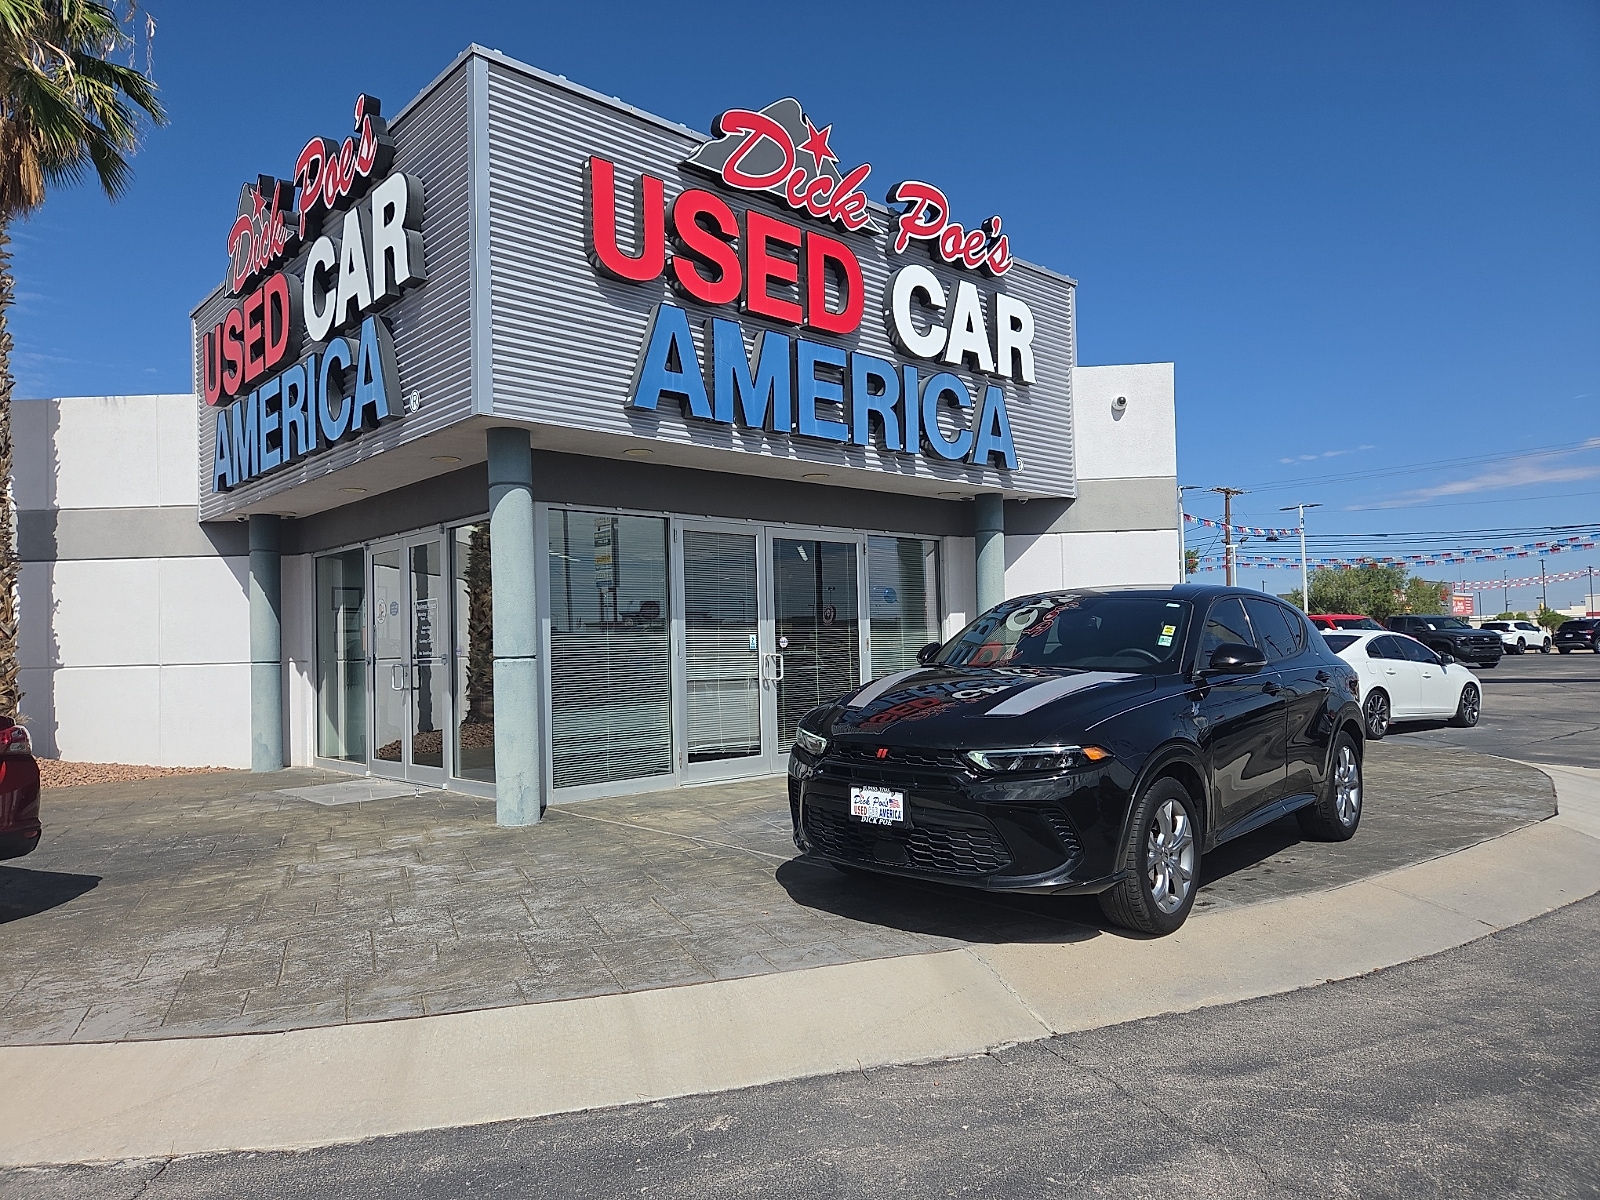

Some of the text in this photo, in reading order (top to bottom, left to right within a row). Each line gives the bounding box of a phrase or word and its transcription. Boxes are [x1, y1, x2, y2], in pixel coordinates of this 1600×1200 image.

[228, 93, 378, 294] Dick Poe's
[589, 155, 1037, 385] USED CAR
[719, 108, 1014, 277] Dick Poe's
[203, 171, 410, 407] USED CAR
[213, 316, 389, 493] AMERICA
[631, 303, 1018, 471] AMERICA
[854, 805, 868, 816] USED
[879, 808, 901, 820] AMERICA
[861, 816, 892, 826] DICK POE
